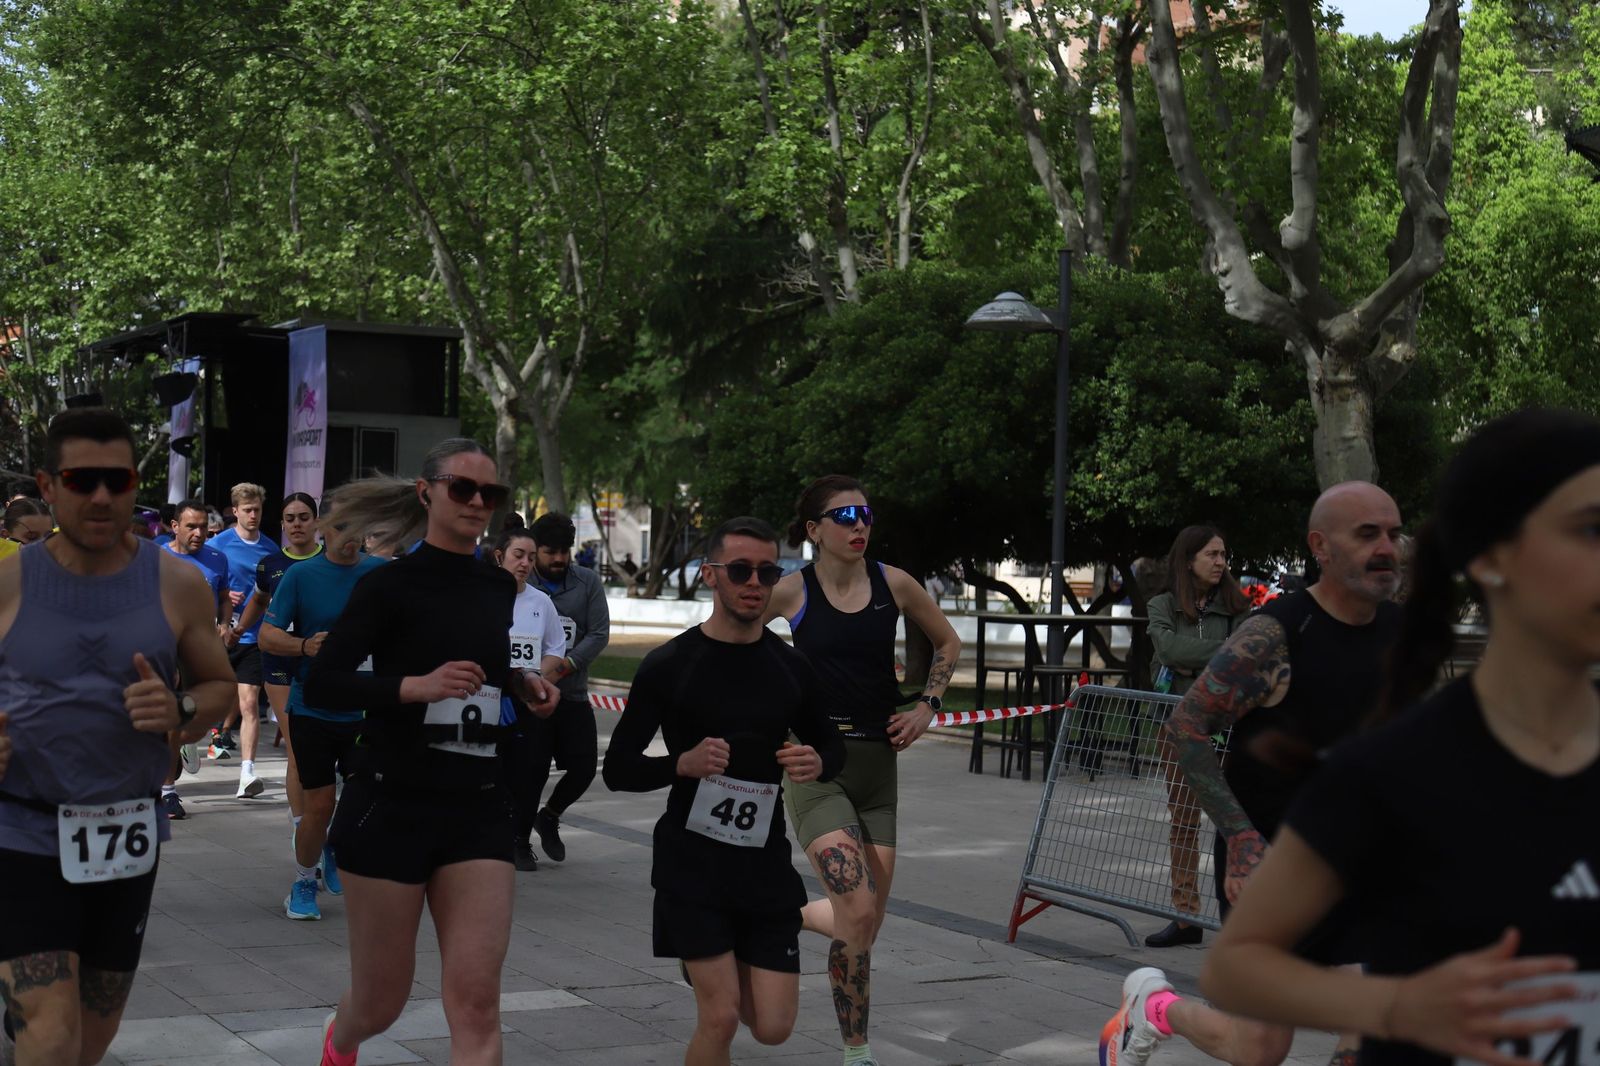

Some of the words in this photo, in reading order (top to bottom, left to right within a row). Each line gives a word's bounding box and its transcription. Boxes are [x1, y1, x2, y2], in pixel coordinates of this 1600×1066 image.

[511, 643, 533, 659] 53
[727, 784, 755, 793] CASTILLA
[711, 798, 757, 831] 48
[72, 822, 149, 863] 176
